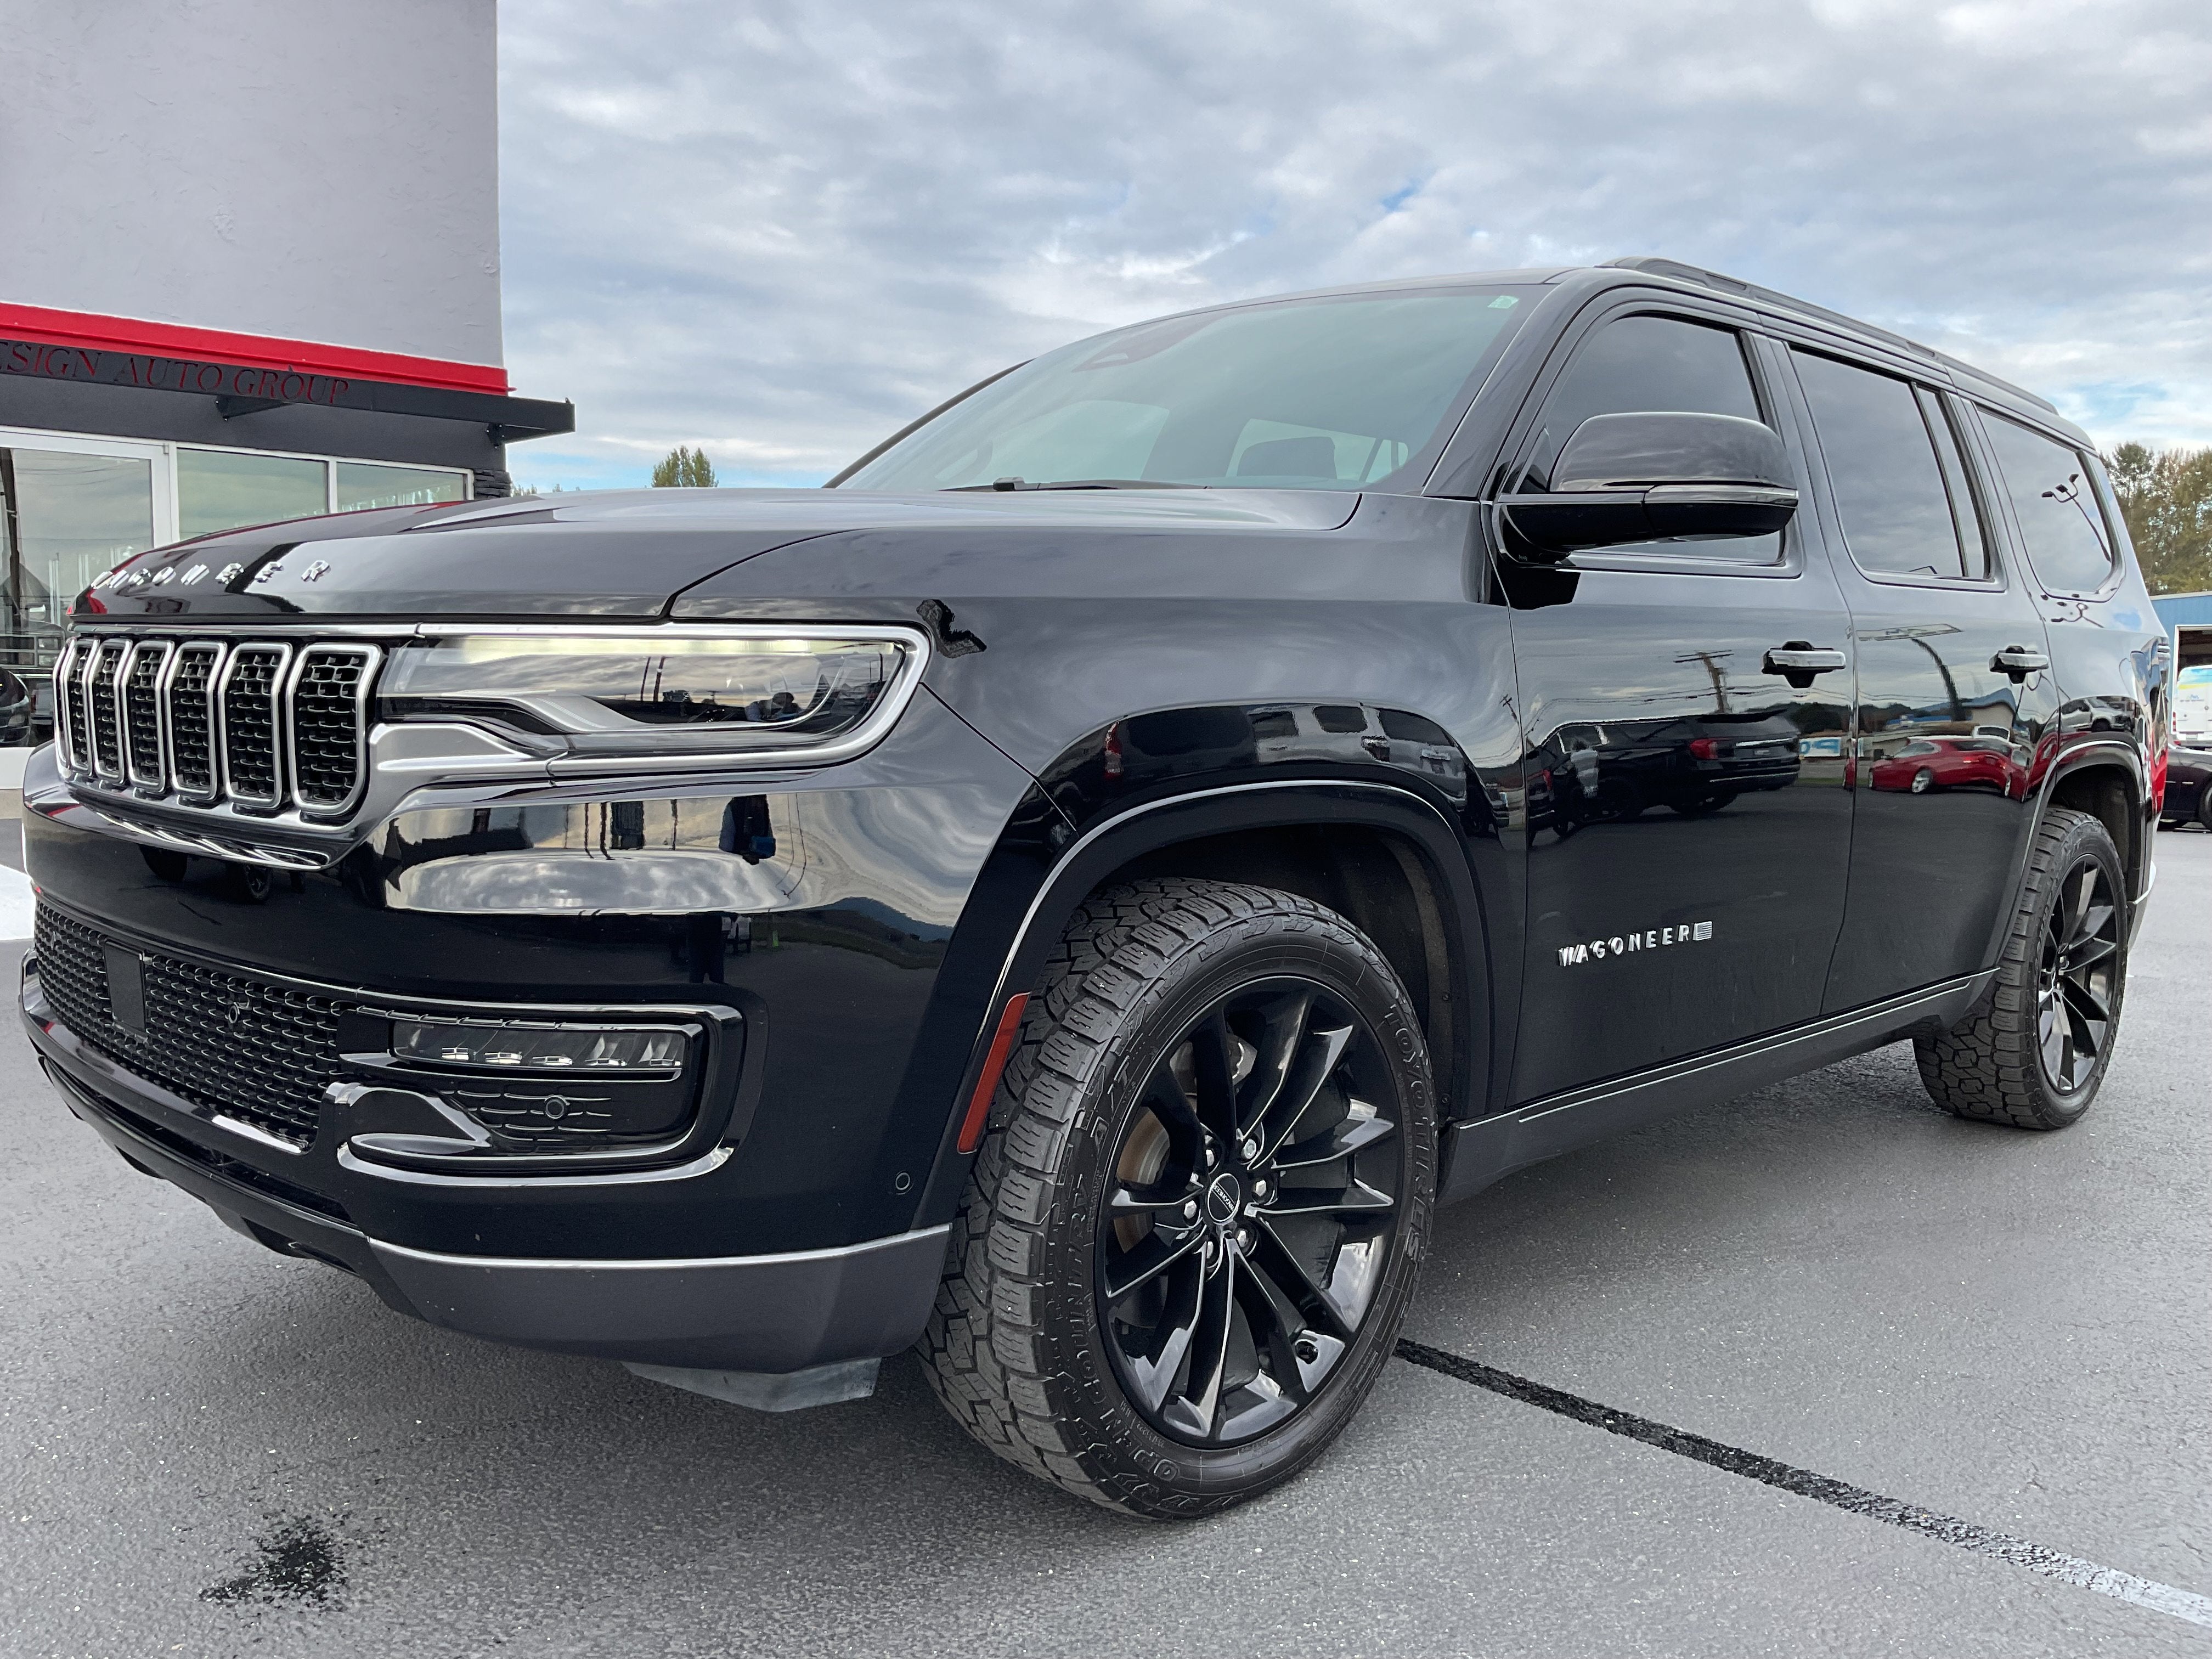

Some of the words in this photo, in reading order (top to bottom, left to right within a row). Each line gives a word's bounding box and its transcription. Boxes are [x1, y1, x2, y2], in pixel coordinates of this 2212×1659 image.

[0, 340, 103, 377] SIGN
[113, 357, 223, 391] AUTO
[233, 369, 349, 404] GROUP
[1556, 924, 1689, 967] WAGONEER
[1384, 1003, 1427, 1108] TOYO
[1405, 1116, 1430, 1263] TIRES
